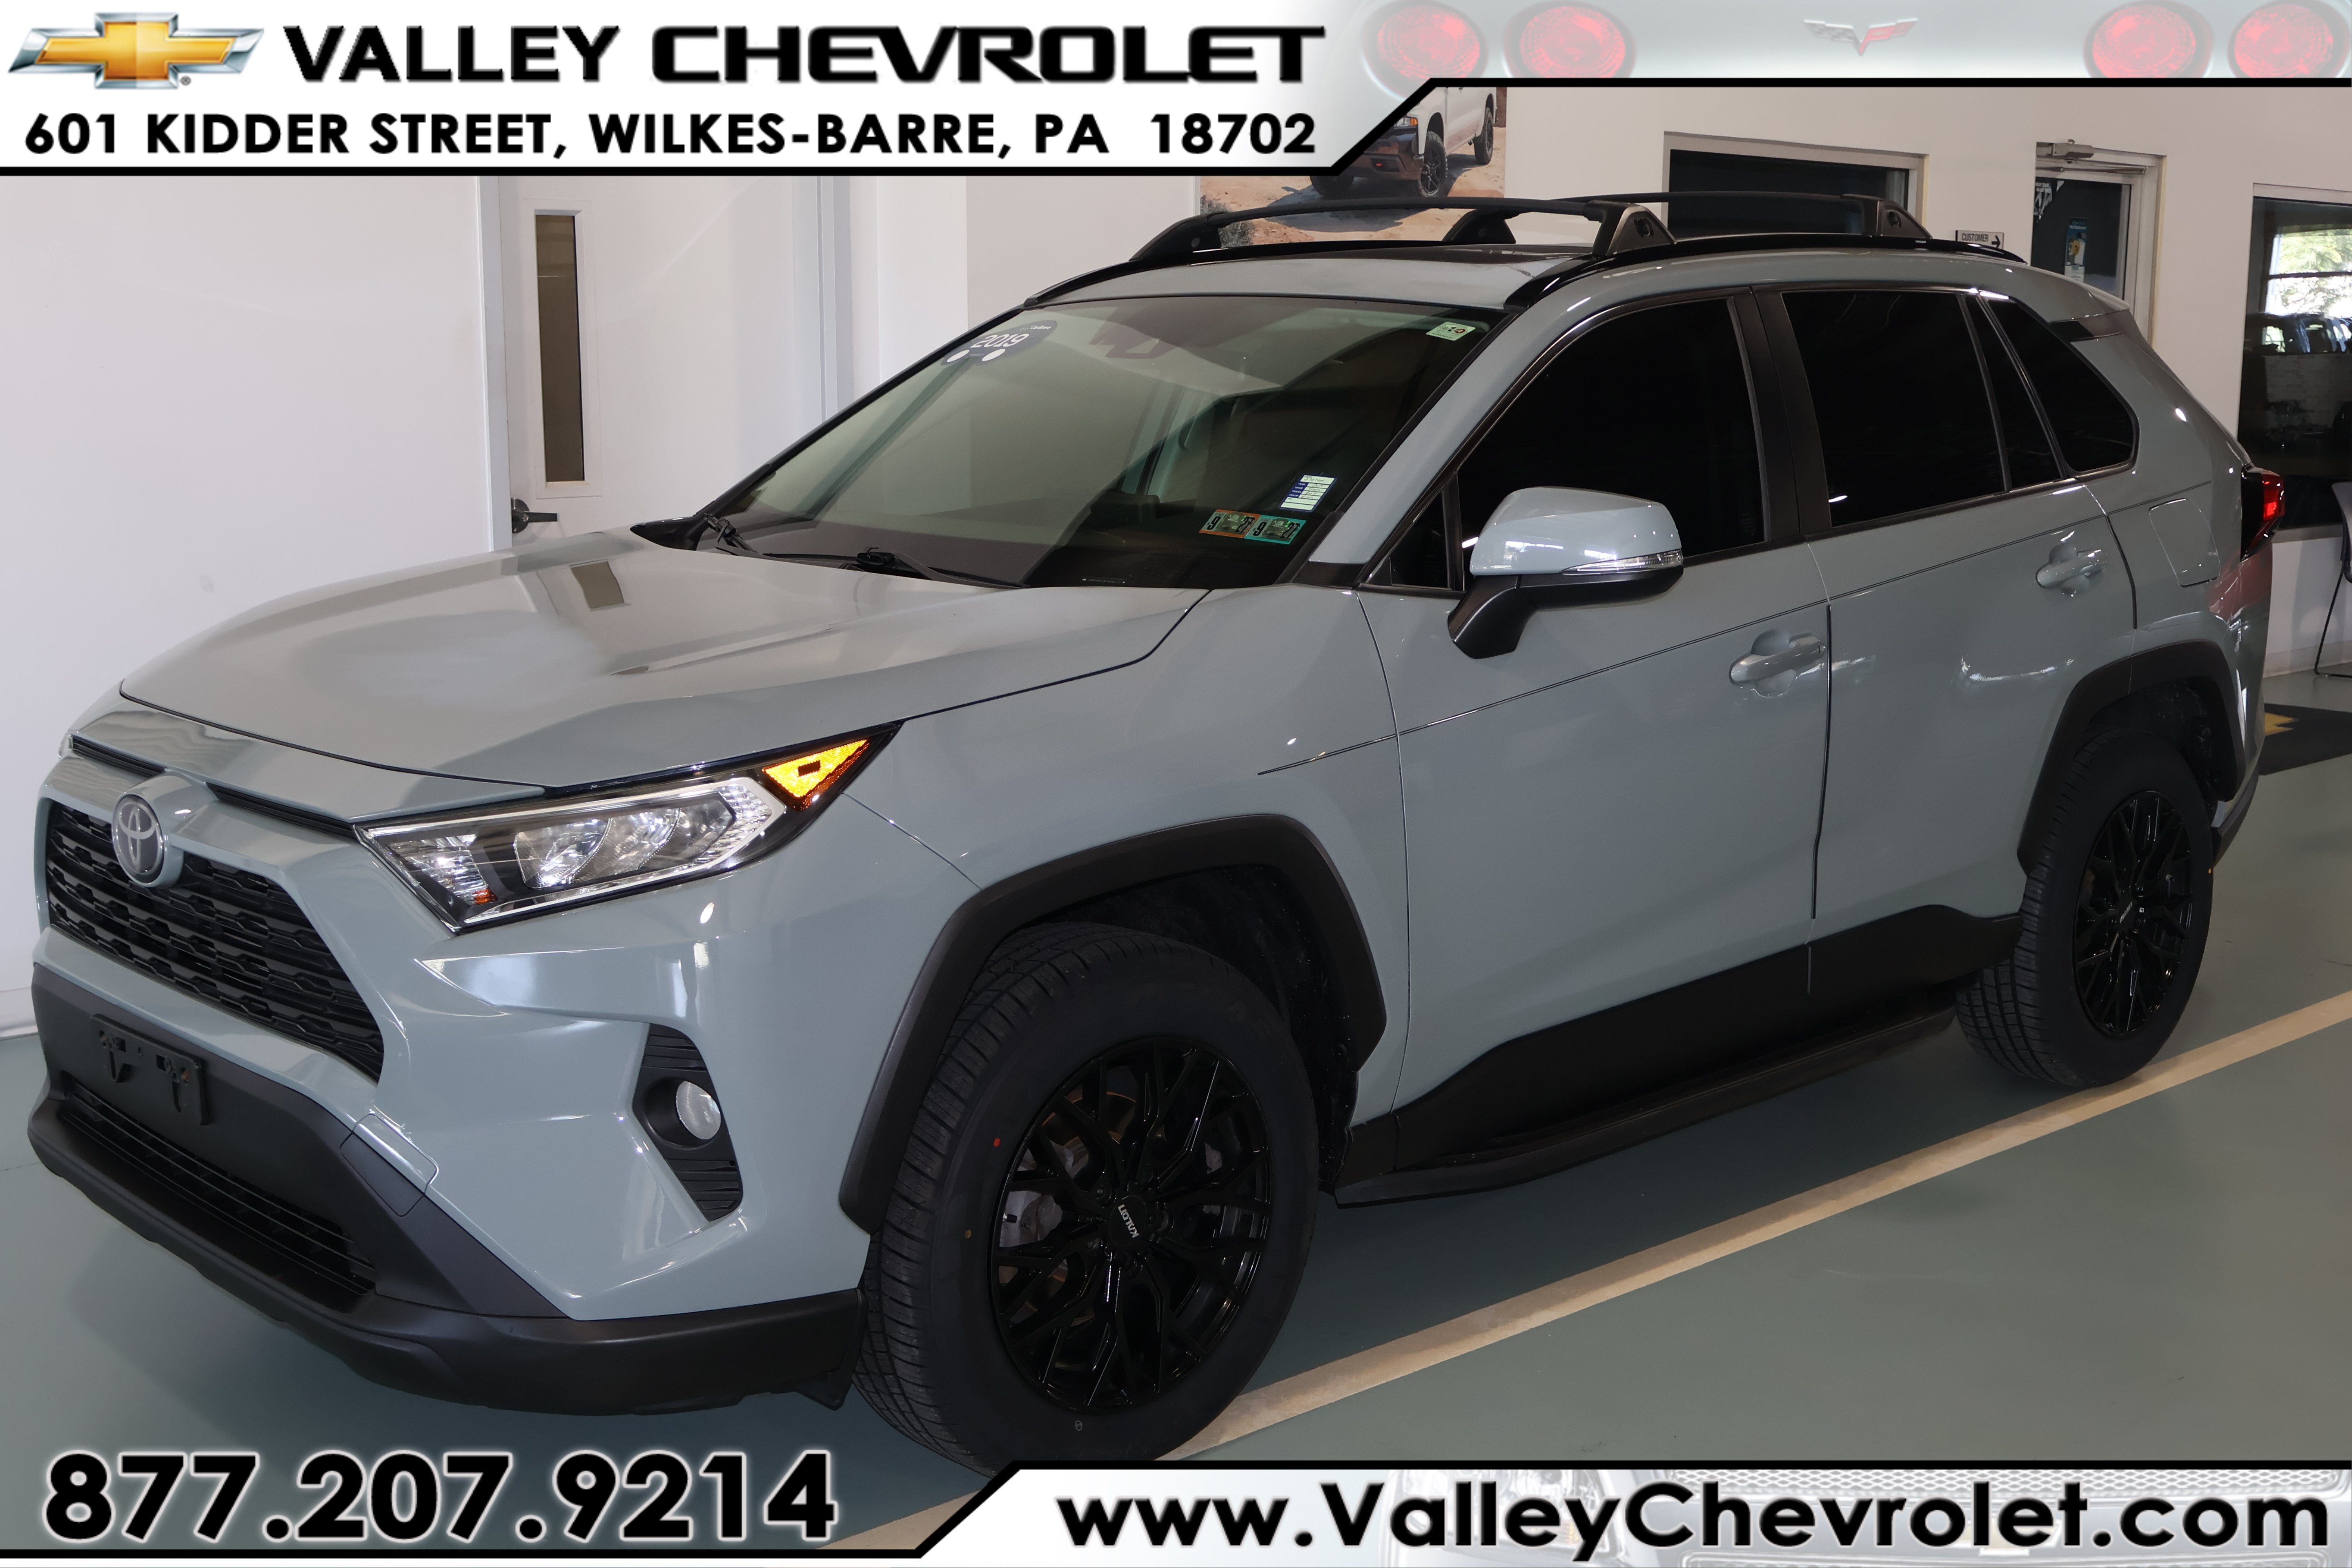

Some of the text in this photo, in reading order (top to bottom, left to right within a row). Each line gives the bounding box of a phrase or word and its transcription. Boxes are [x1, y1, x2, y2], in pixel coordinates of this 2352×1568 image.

[1961, 233, 1989, 242] CUSTOMER
[970, 333, 1029, 348] 2019
[1207, 516, 1221, 531] 9
[1253, 521, 1267, 537] 9
